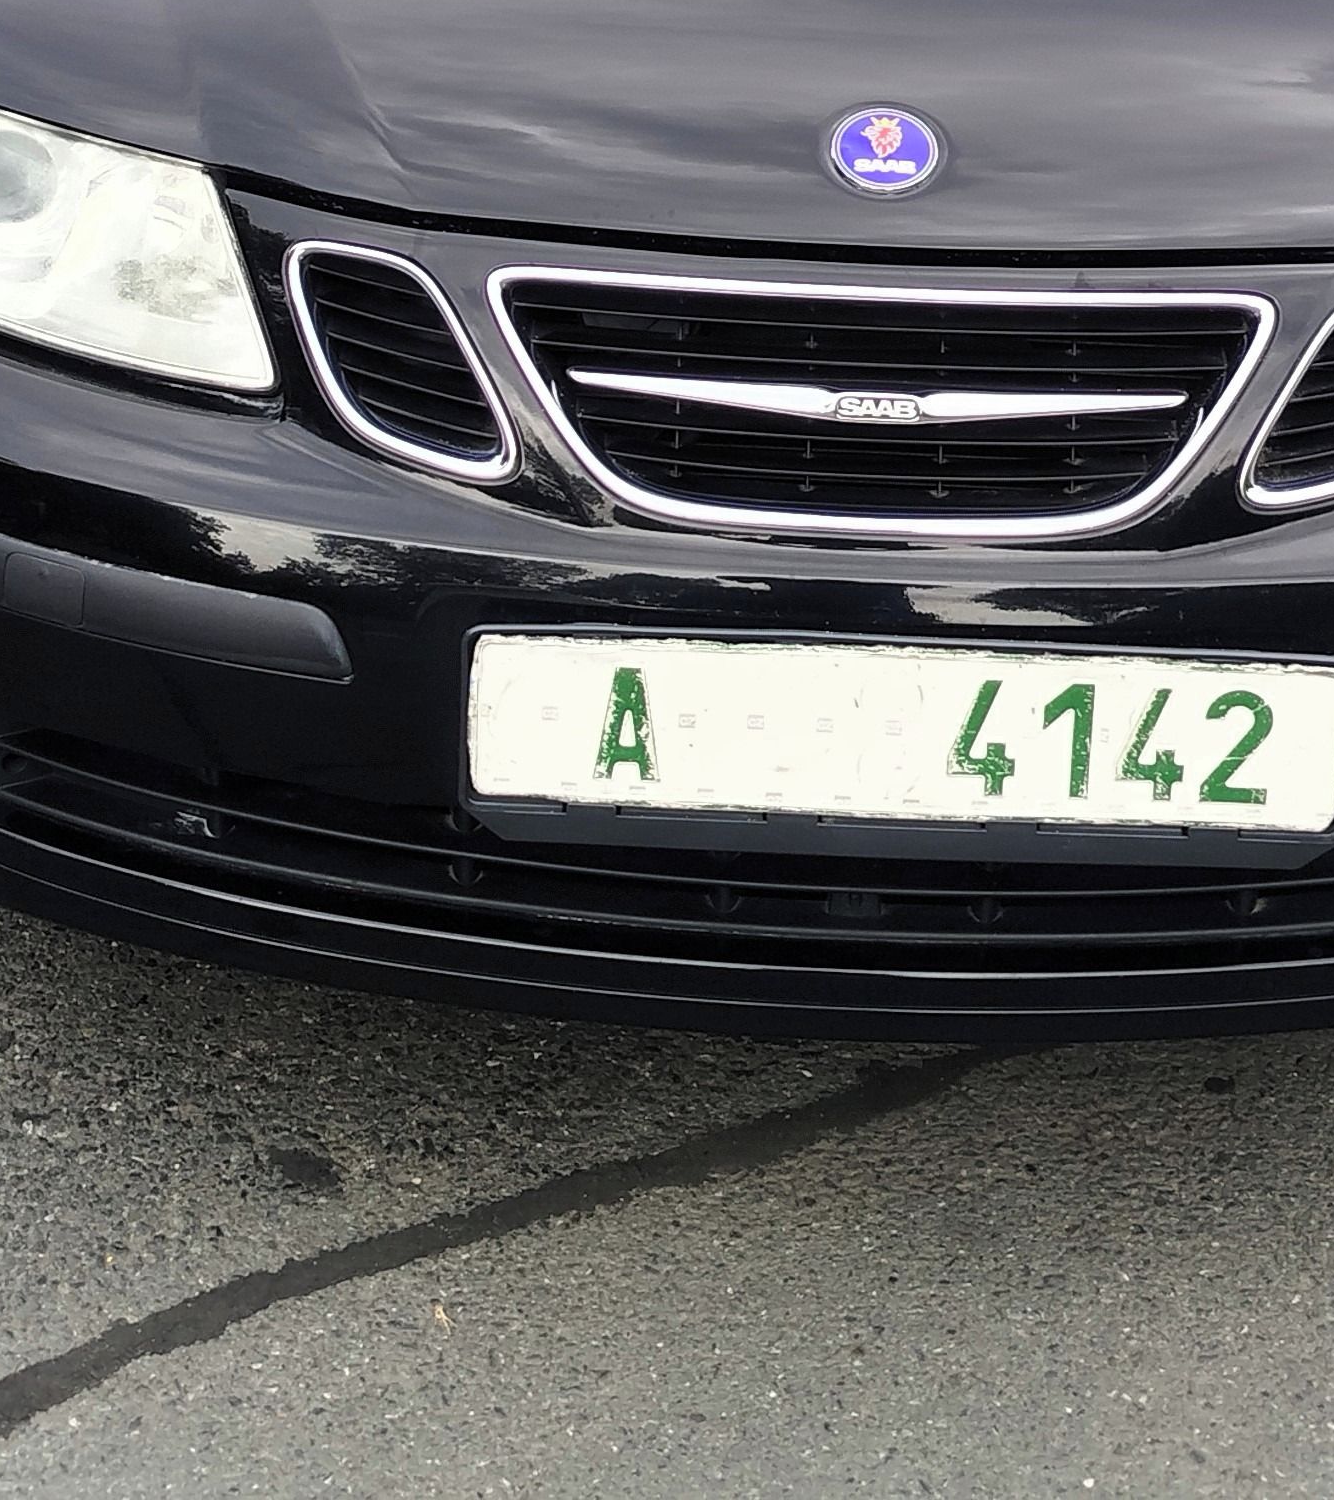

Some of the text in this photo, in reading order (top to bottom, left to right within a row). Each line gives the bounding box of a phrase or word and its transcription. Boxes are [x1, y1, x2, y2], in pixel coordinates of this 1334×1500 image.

[854, 158, 917, 175] SAAB
[837, 396, 917, 419] SAAB
[594, 667, 1273, 804] A 4142
